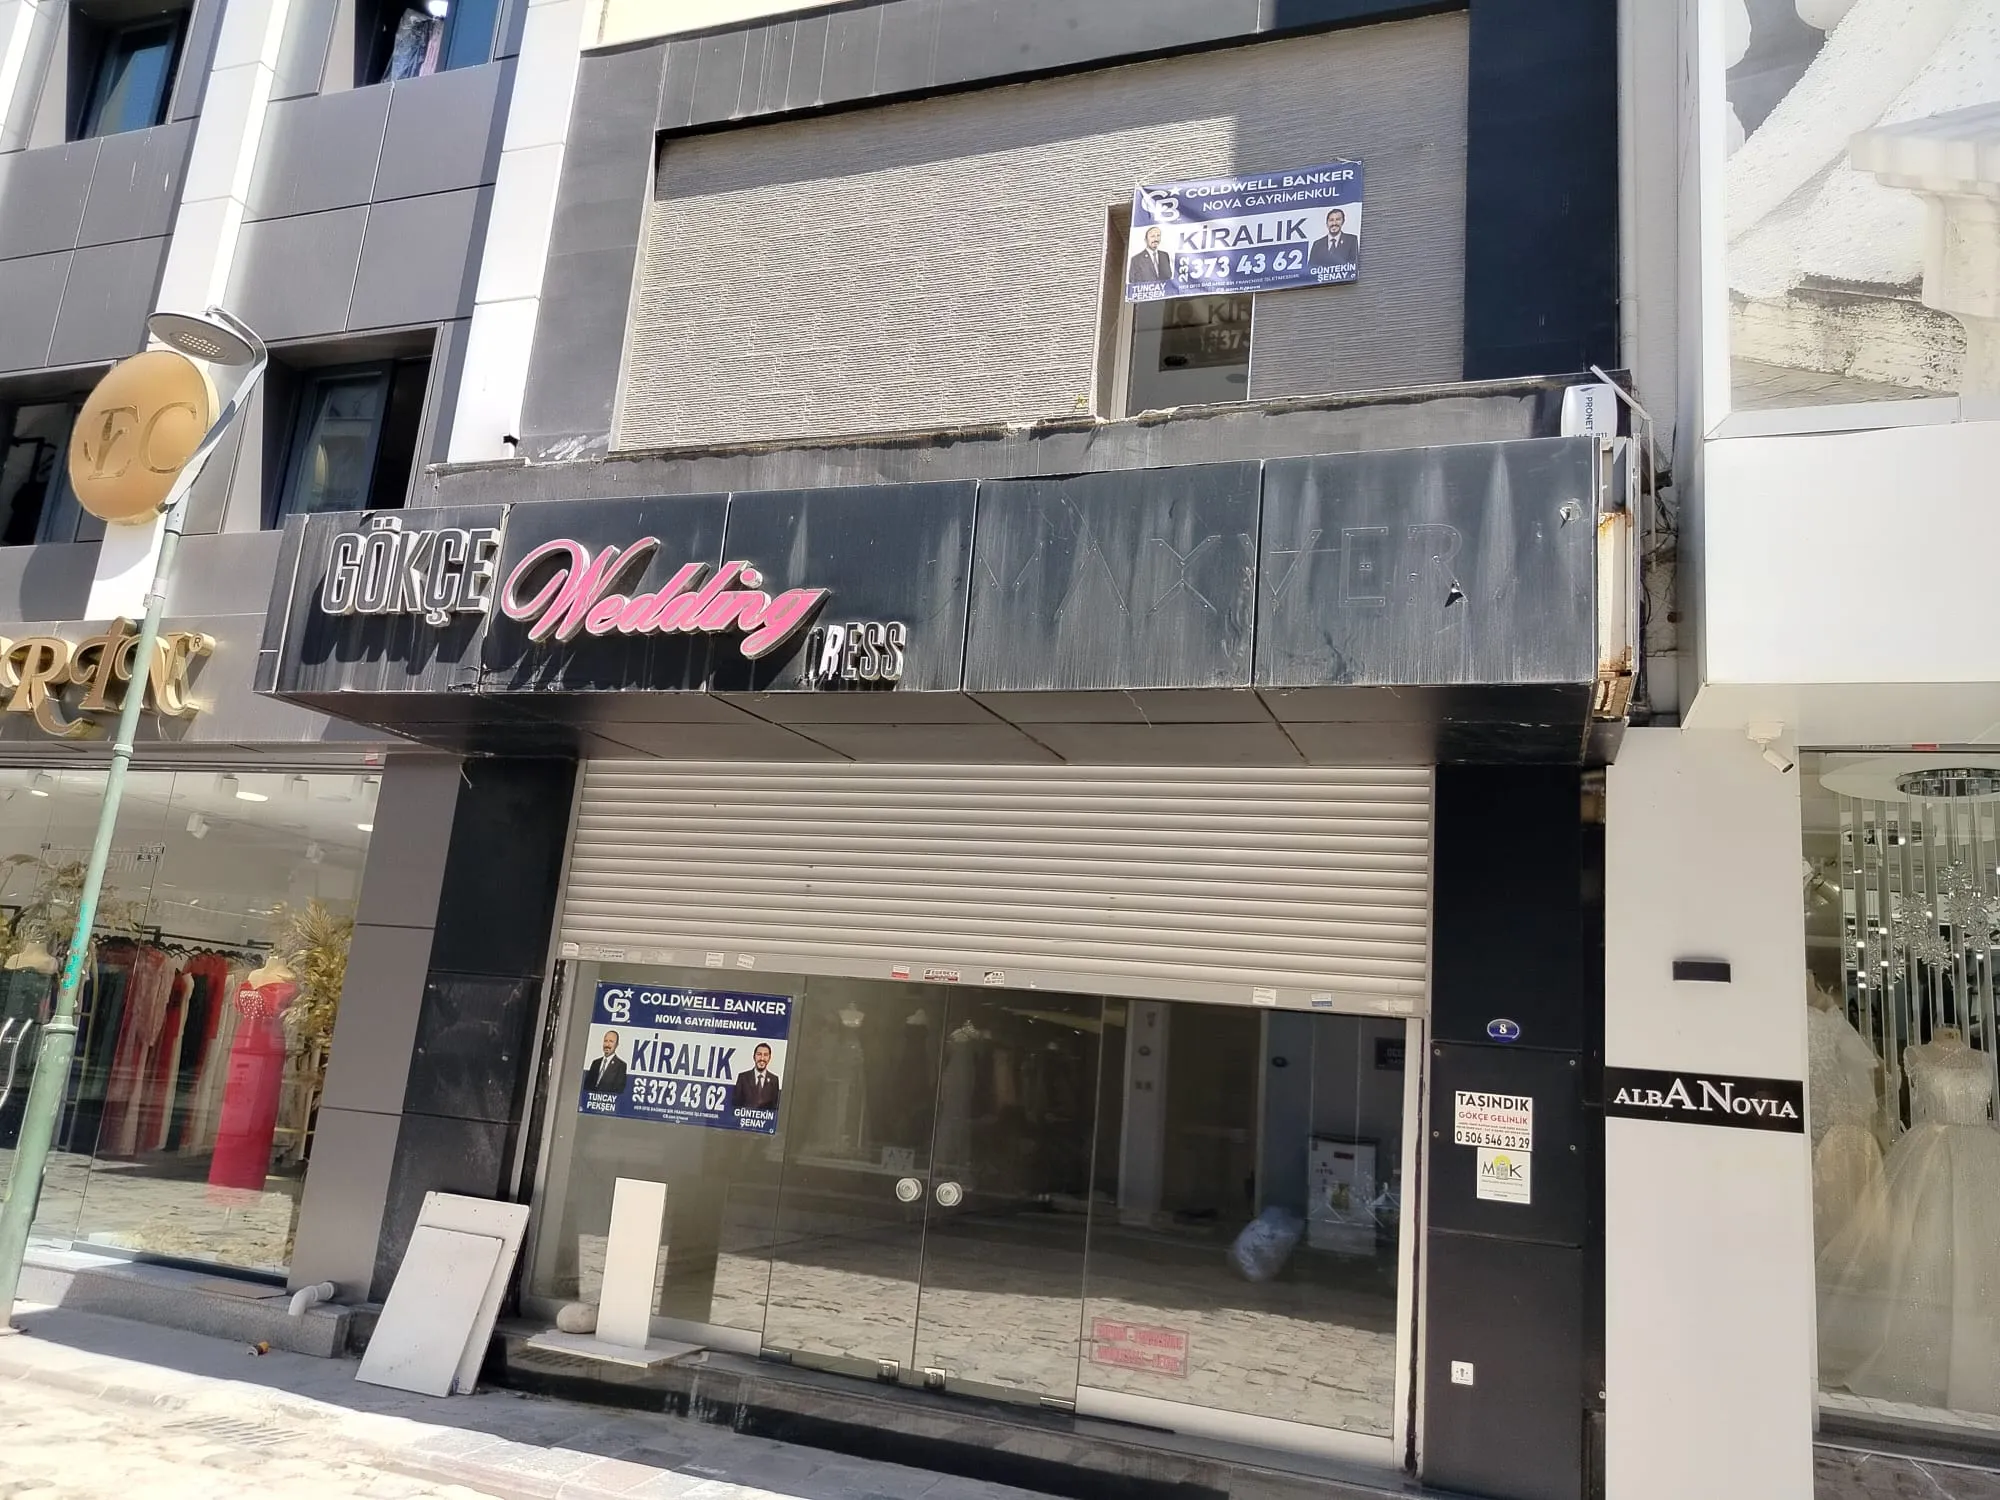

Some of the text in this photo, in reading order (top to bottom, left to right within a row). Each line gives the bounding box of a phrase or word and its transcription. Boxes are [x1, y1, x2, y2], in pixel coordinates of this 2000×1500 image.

[1185, 170, 1354, 199] COLDWELL BANKER
[1202, 186, 1340, 212] NOVA GAYRİMENKUL
[1179, 217, 1308, 250] KİRALIK
[1190, 249, 1303, 279] 373 43 62
[1310, 262, 1357, 275] GÜNTEKİN
[1317, 272, 1347, 283] ŞENAY
[1132, 283, 1166, 293] TUNCAY
[1585, 396, 1594, 431] PRONET
[321, 516, 500, 627] GÖKÇE
[501, 536, 831, 660] Wedding
[640, 992, 786, 1016] COLDWELL BANKER
[655, 1014, 757, 1031] NOVA GAYRİMENKUL
[1499, 1023, 1508, 1034] 8
[630, 1033, 736, 1080] KİRALIK
[588, 1092, 617, 1103] TUNCAY
[632, 1078, 648, 1103] 232
[647, 1079, 727, 1111] 373 43 62
[586, 1101, 616, 1113] PEKŞEN
[1457, 1093, 1529, 1112] TAŞINDIK
[734, 1108, 774, 1120] GÜNTEKİN
[740, 1117, 766, 1129] ŞENAY
[1458, 1110, 1529, 1126] GÖKÇE GELİNLİK
[1456, 1130, 1530, 1149] 0 506 546 23 29
